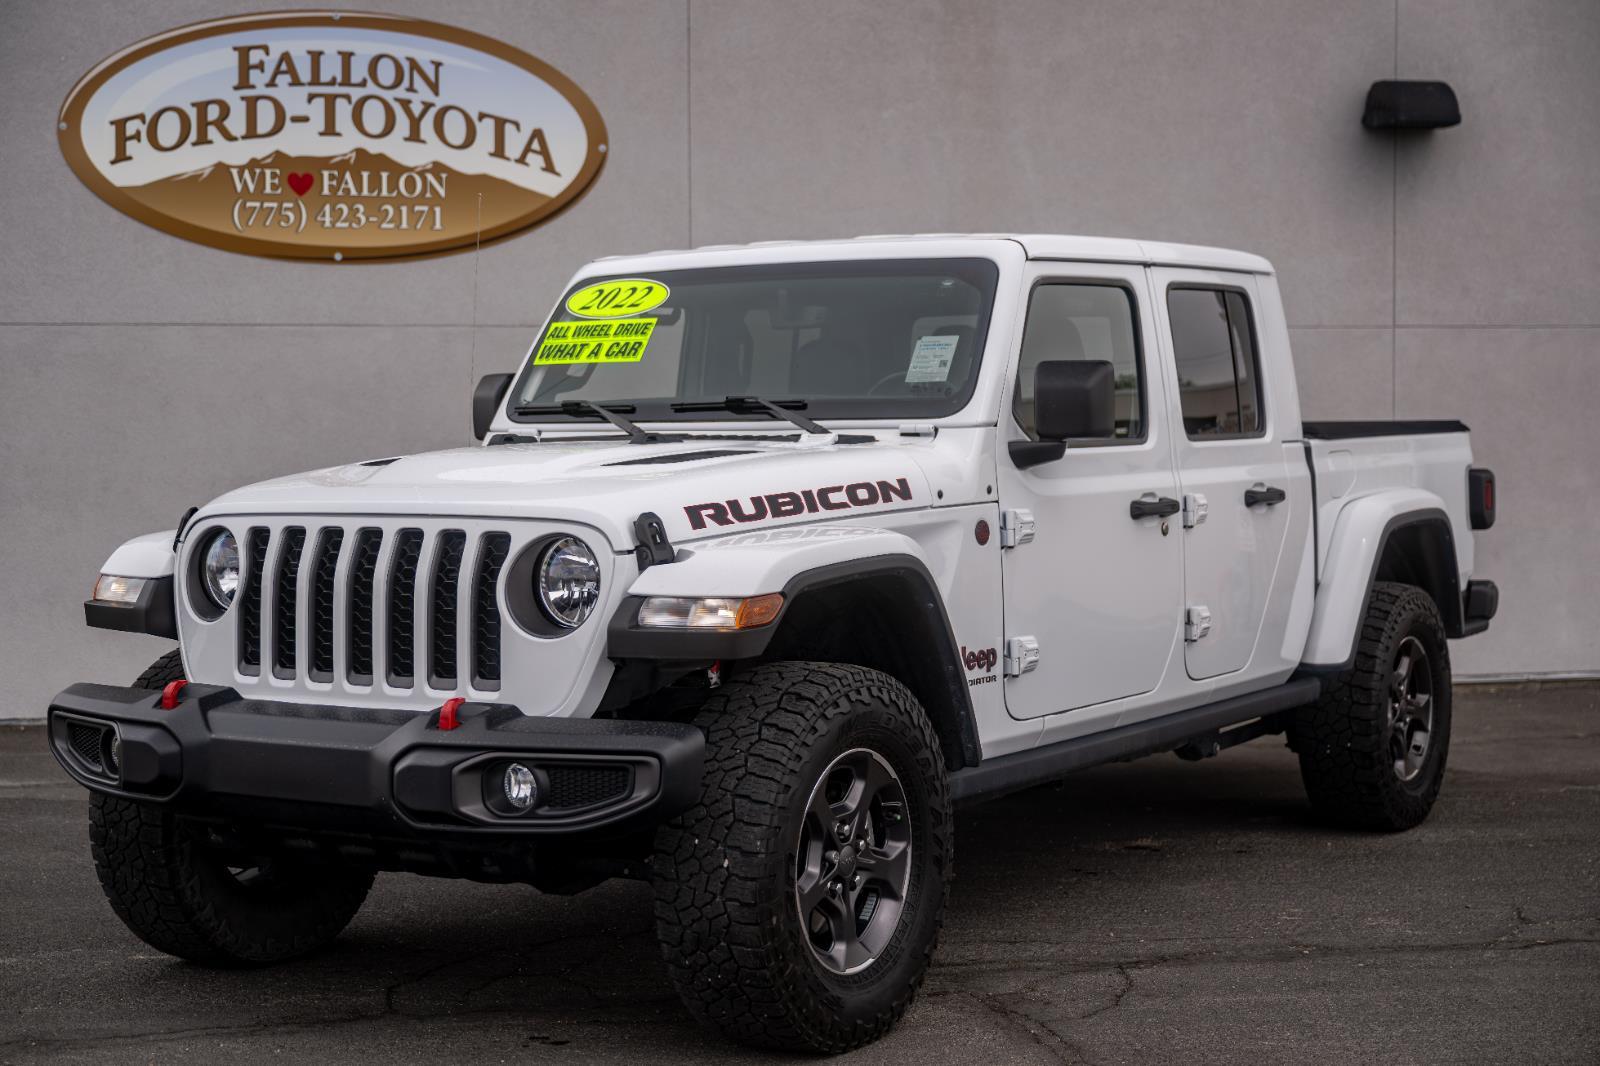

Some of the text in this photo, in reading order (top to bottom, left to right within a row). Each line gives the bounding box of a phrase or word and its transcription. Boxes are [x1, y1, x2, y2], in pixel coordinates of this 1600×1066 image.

[232, 43, 443, 98] FALLON
[109, 92, 562, 178] FORD-TOYOTA
[230, 168, 448, 200] WE FALLON
[232, 200, 443, 232] (775) 423-2171
[579, 285, 655, 310] 2022
[547, 322, 653, 340] ALL WHEEL DRIVE
[539, 341, 643, 360] WHAT A CAR
[683, 477, 912, 530] RUBICON
[968, 675, 997, 686] DIATOR
